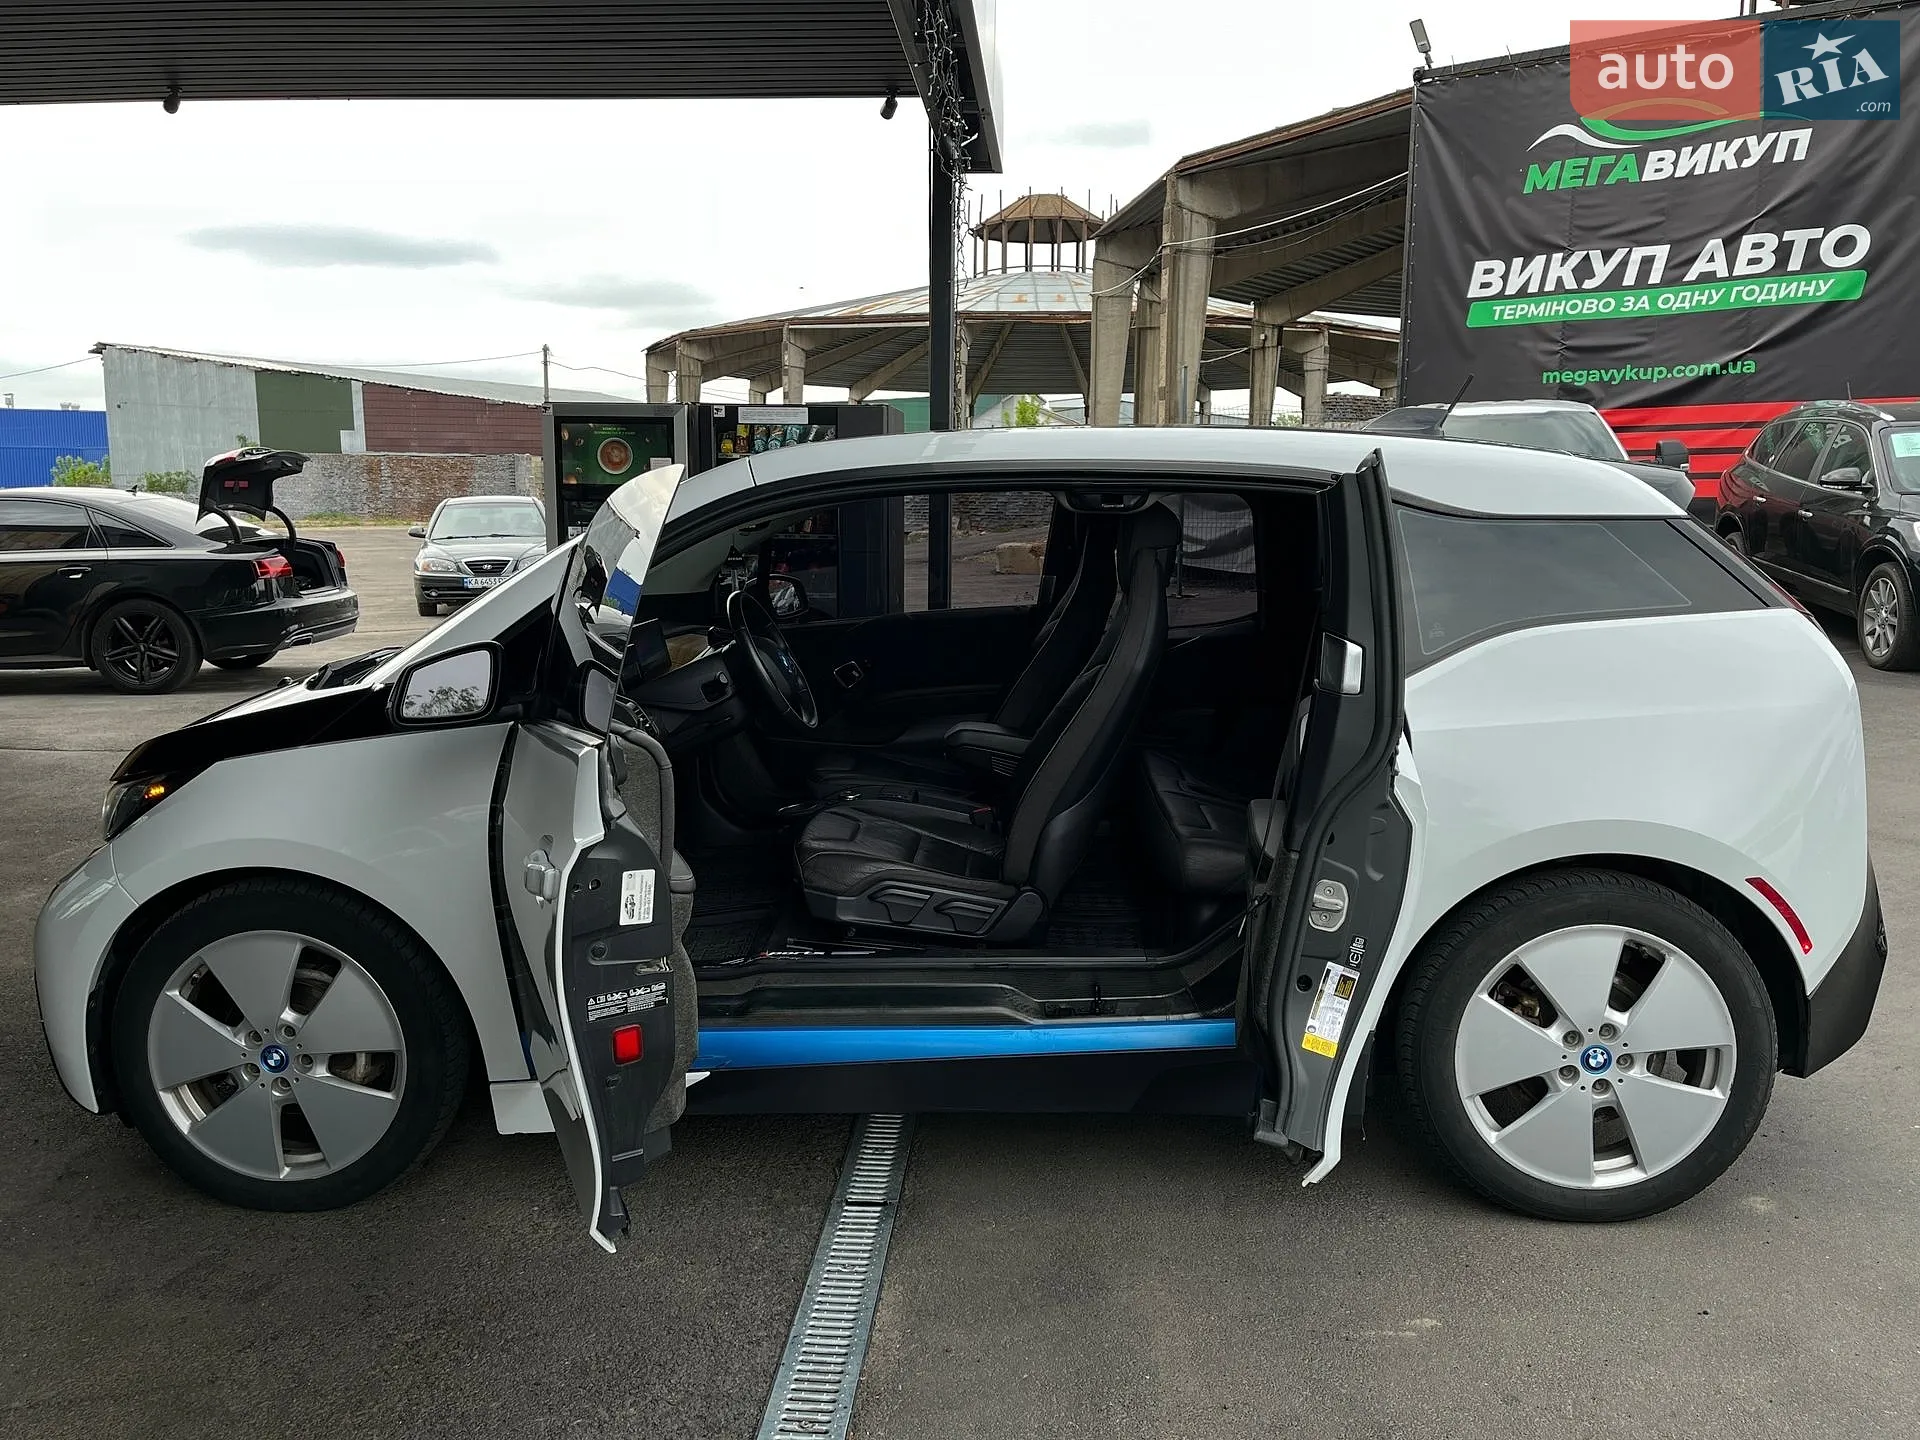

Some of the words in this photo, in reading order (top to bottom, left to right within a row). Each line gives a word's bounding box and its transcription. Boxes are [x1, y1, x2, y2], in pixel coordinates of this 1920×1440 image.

[1523, 128, 1813, 194] МЕГАВИКУП
[1466, 244, 1671, 299] ВИКУП
[1683, 224, 1872, 282] АВТО
[1493, 297, 1616, 321] ТЕРМІНОВО
[1621, 295, 1650, 312] ЗА
[1656, 290, 1722, 311] ОДНУ
[1729, 278, 1835, 305] ГОДИНУ
[1542, 358, 1756, 386] megavykup.com.ua
